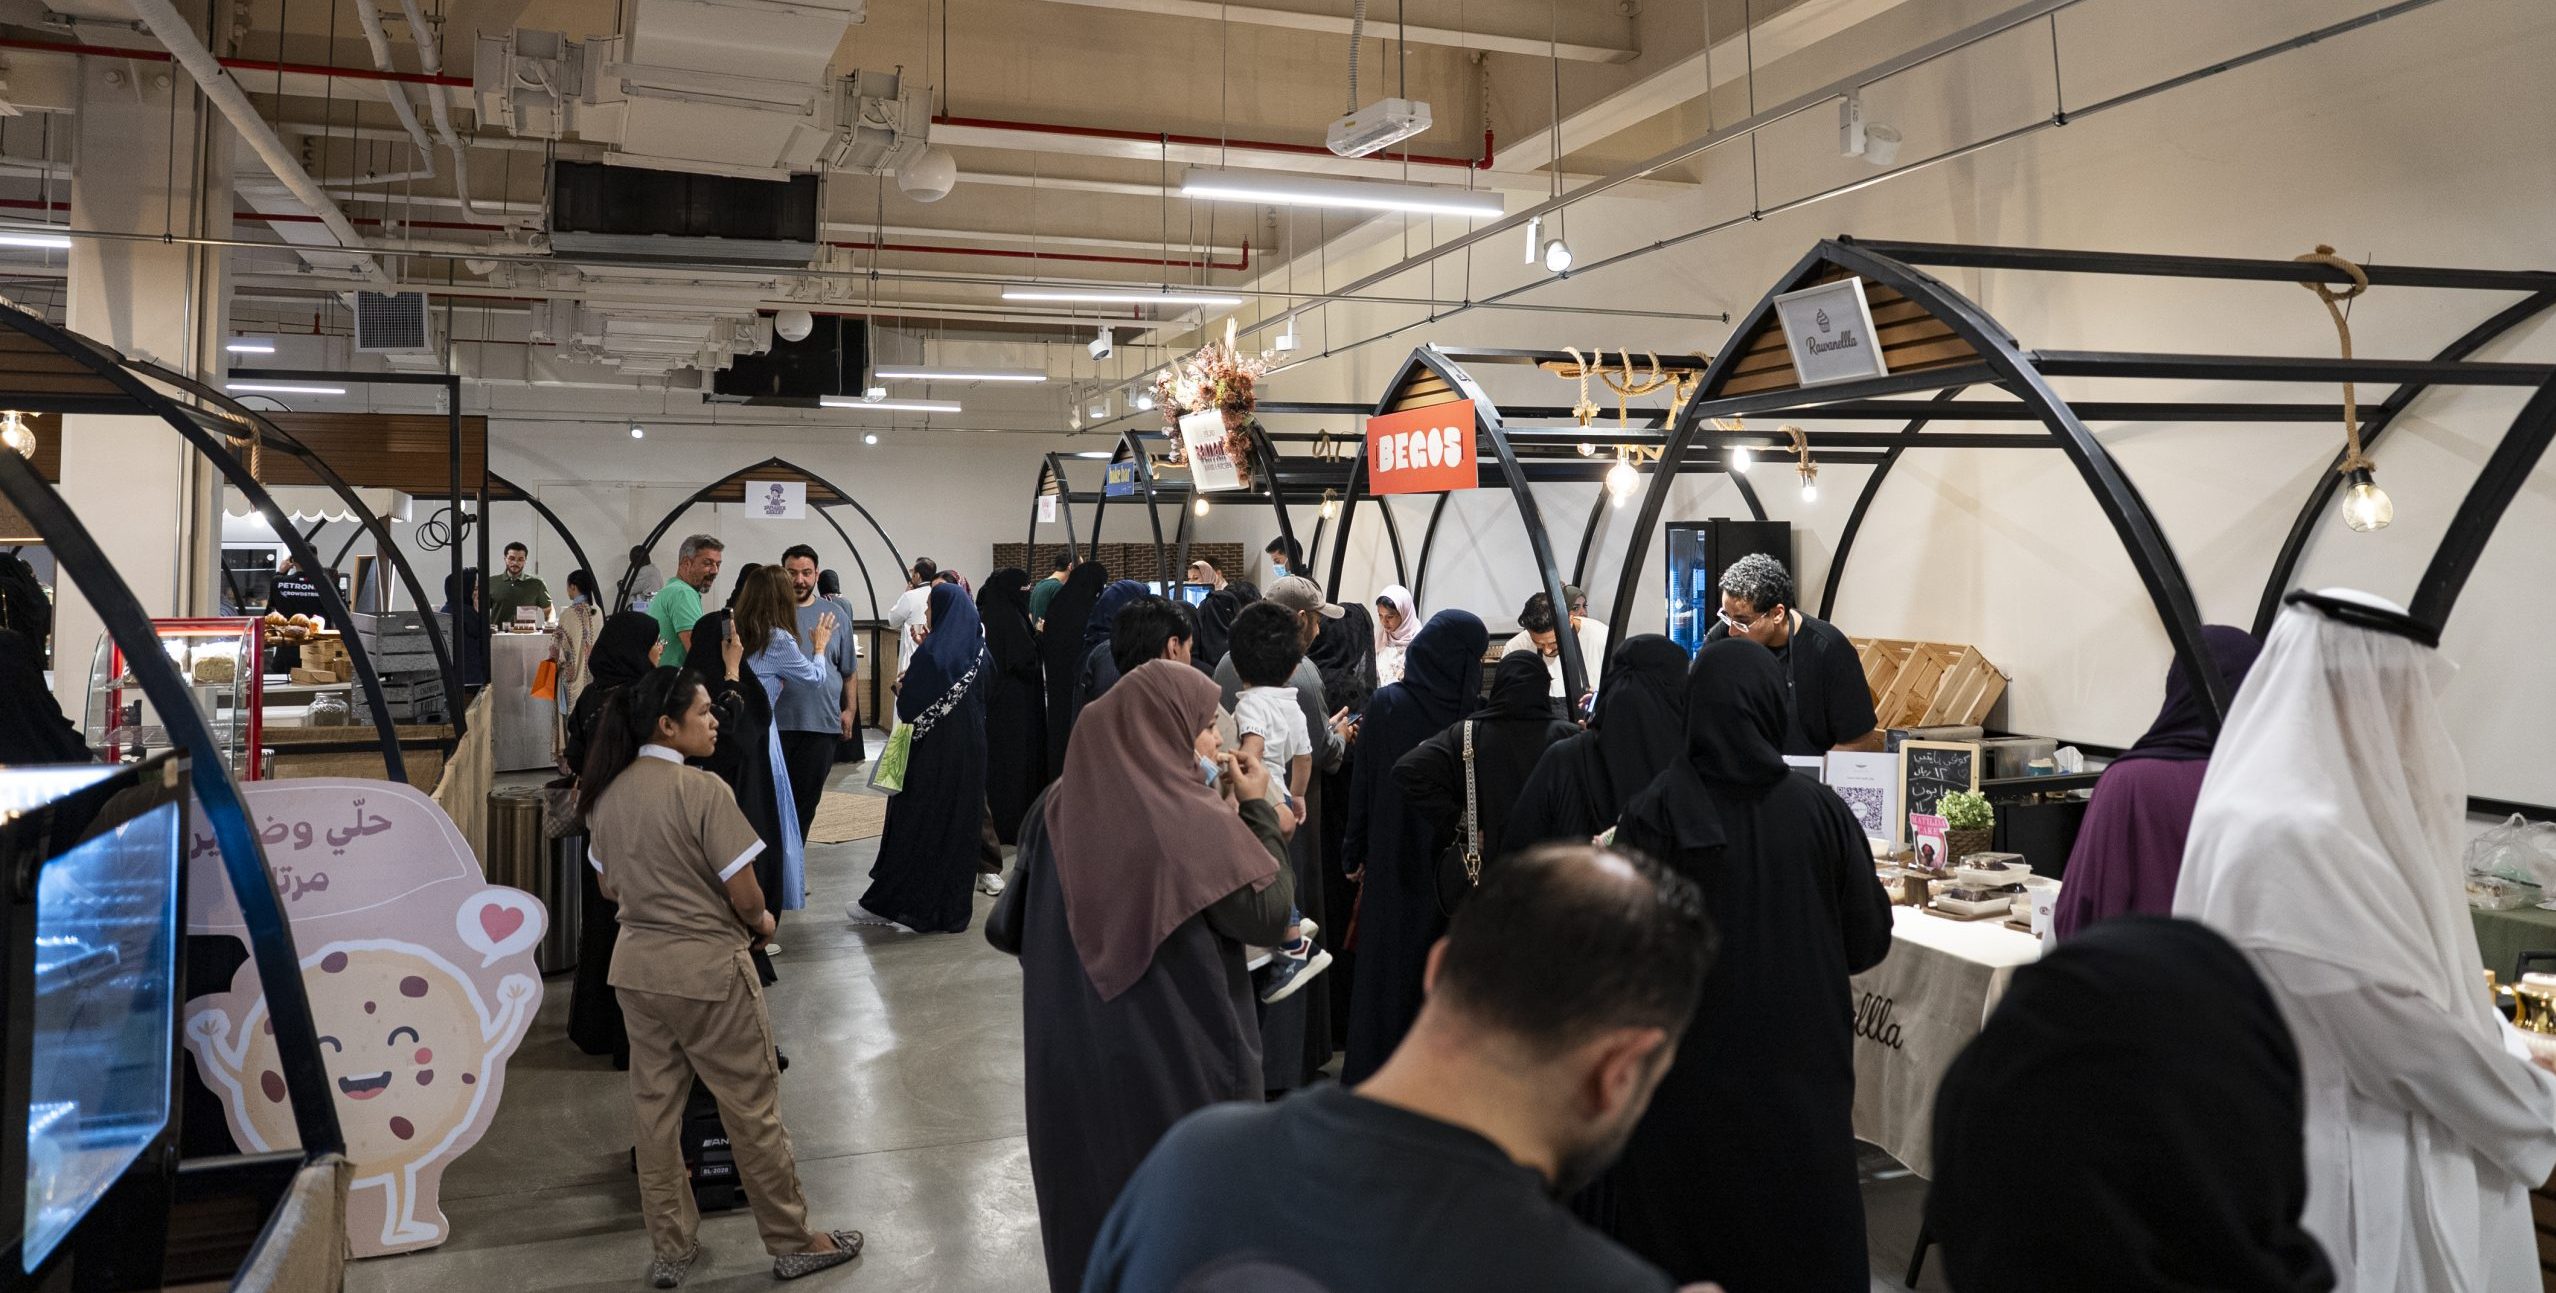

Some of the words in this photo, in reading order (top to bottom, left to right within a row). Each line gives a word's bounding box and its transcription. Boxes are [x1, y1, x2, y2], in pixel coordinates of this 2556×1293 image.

[1379, 426, 1462, 473] BEGOS
[278, 582, 316, 590] PETRON
[273, 866, 330, 902] مرتا
[1855, 991, 1904, 1049] llla
